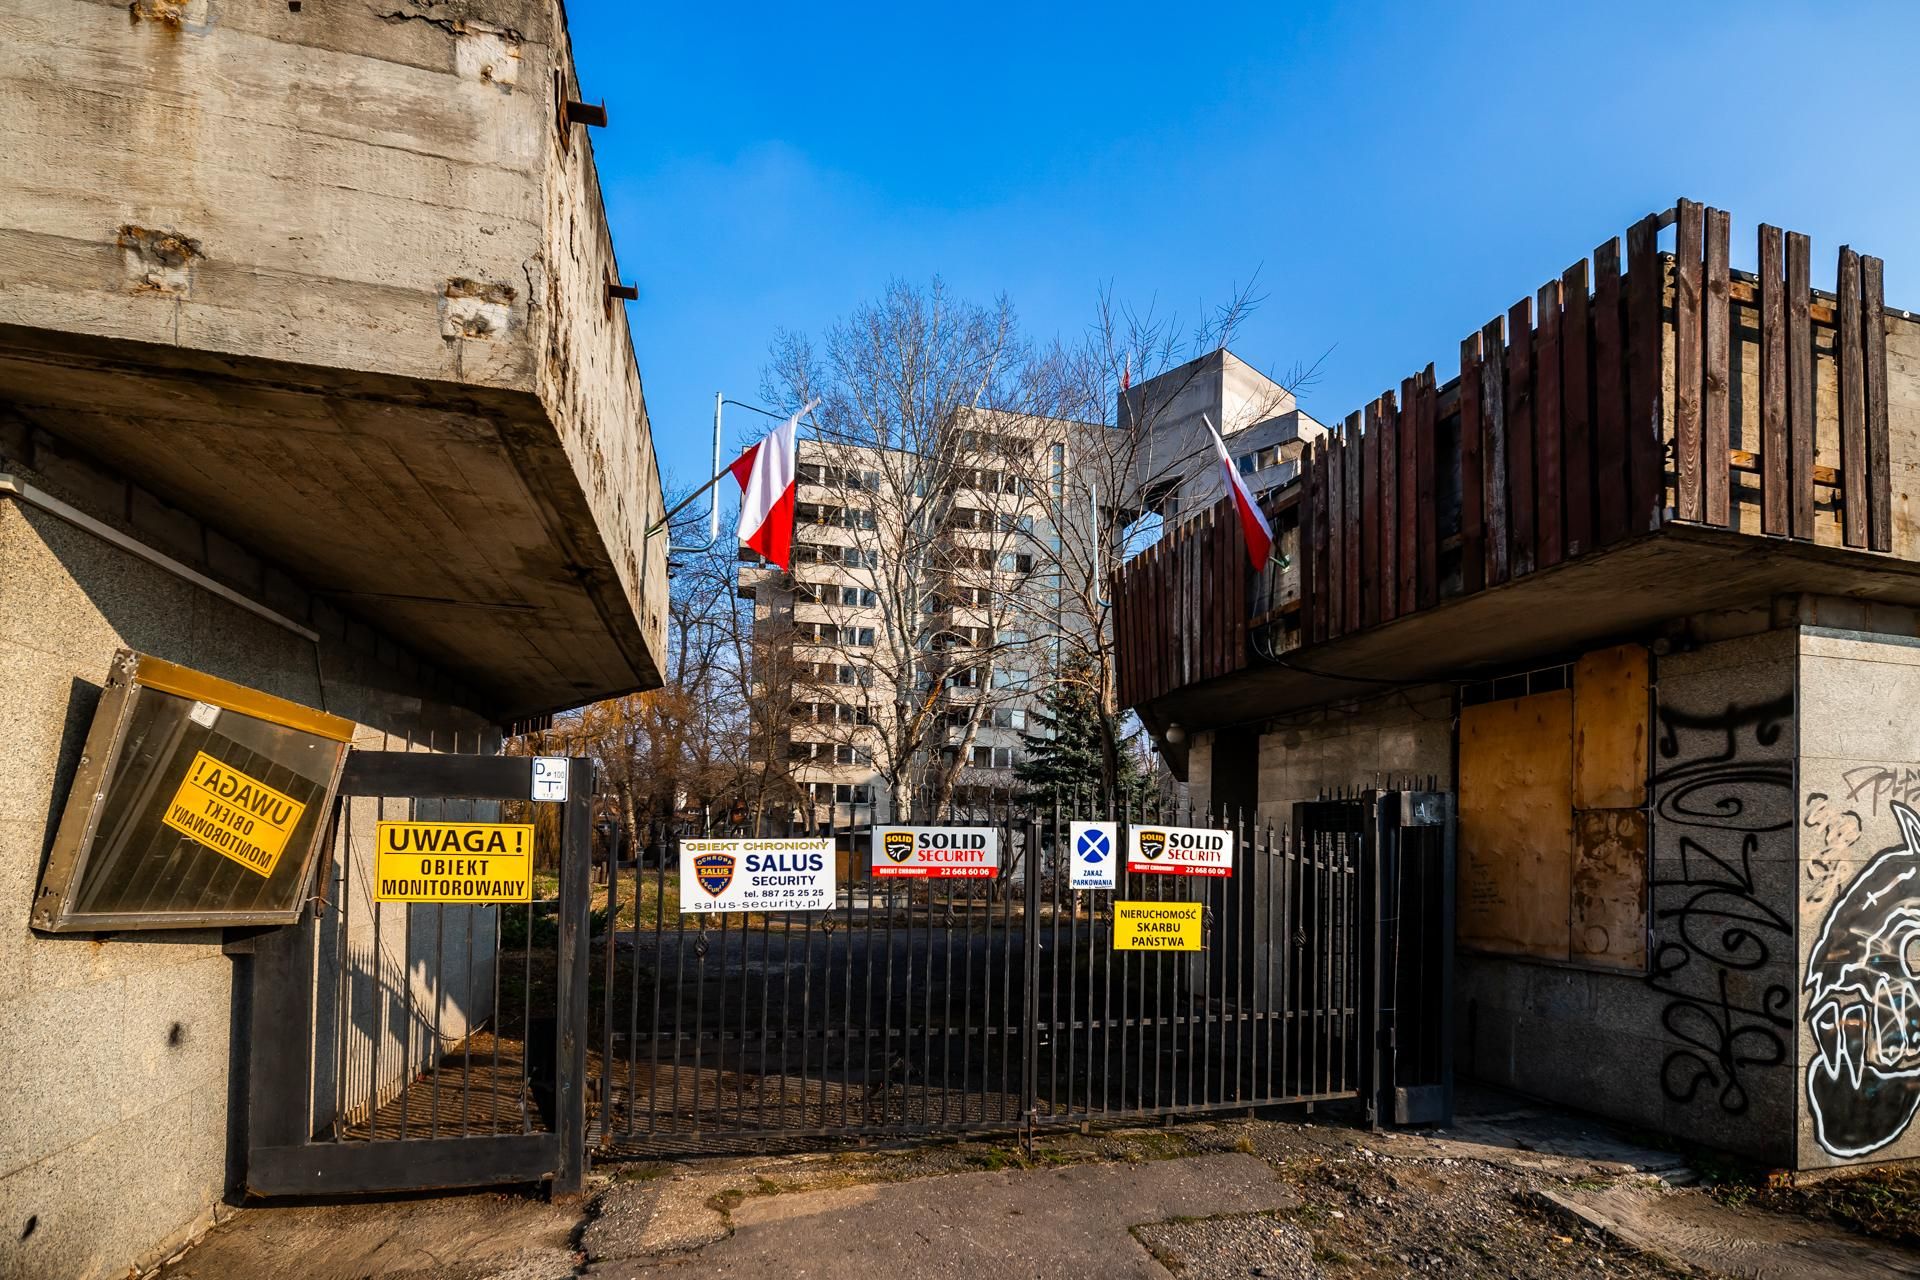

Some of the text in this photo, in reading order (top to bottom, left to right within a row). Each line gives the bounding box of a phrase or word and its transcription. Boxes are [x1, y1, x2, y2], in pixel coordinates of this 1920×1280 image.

[535, 763, 546, 775] D
[389, 828, 507, 853] UWAGA
[886, 835, 912, 843] SOLID
[918, 833, 986, 849] SOLID
[1141, 833, 1164, 842] SOLID
[1168, 832, 1223, 850] SOLID
[685, 841, 829, 851] OBIEKT CHRONIONY
[697, 855, 732, 865] OCHRONA
[917, 850, 985, 862] SECURITY
[1168, 849, 1221, 862] SECURITY
[421, 859, 489, 876] OBIEKT
[745, 853, 823, 872] SALUS
[979, 868, 990, 876] 06
[752, 875, 816, 886] SECURITY
[382, 879, 525, 896] MONITOROWANY
[744, 889, 824, 898] tel. 887 25 25 25
[694, 898, 820, 910] salus-security.pl
[1120, 909, 1197, 919] NIERUCHOMOŚĆ
[1137, 922, 1181, 932] SKARBU
[1131, 934, 1185, 946] PAŃSTWA
